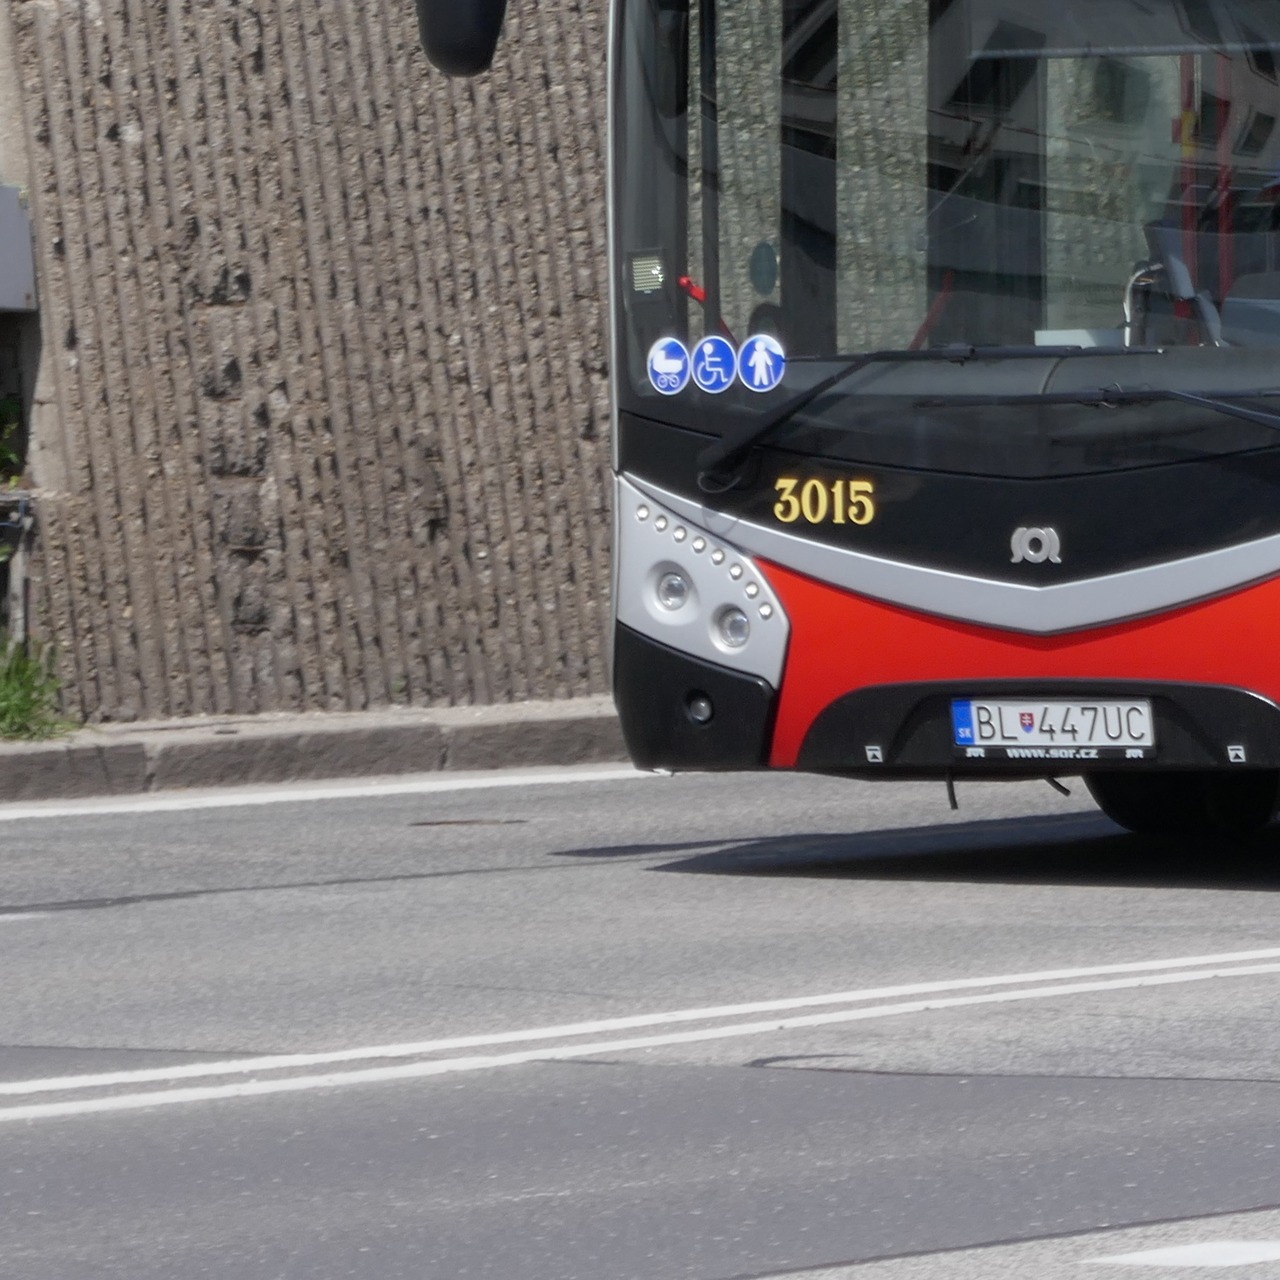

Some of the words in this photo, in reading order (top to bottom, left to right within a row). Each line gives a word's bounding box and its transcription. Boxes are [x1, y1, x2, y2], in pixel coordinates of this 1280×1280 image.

[773, 478, 875, 525] 3015
[958, 728, 973, 739] SK
[976, 706, 1018, 741] BL
[1038, 706, 1146, 742] 447UC
[1006, 748, 1099, 759] www.sor.cz
